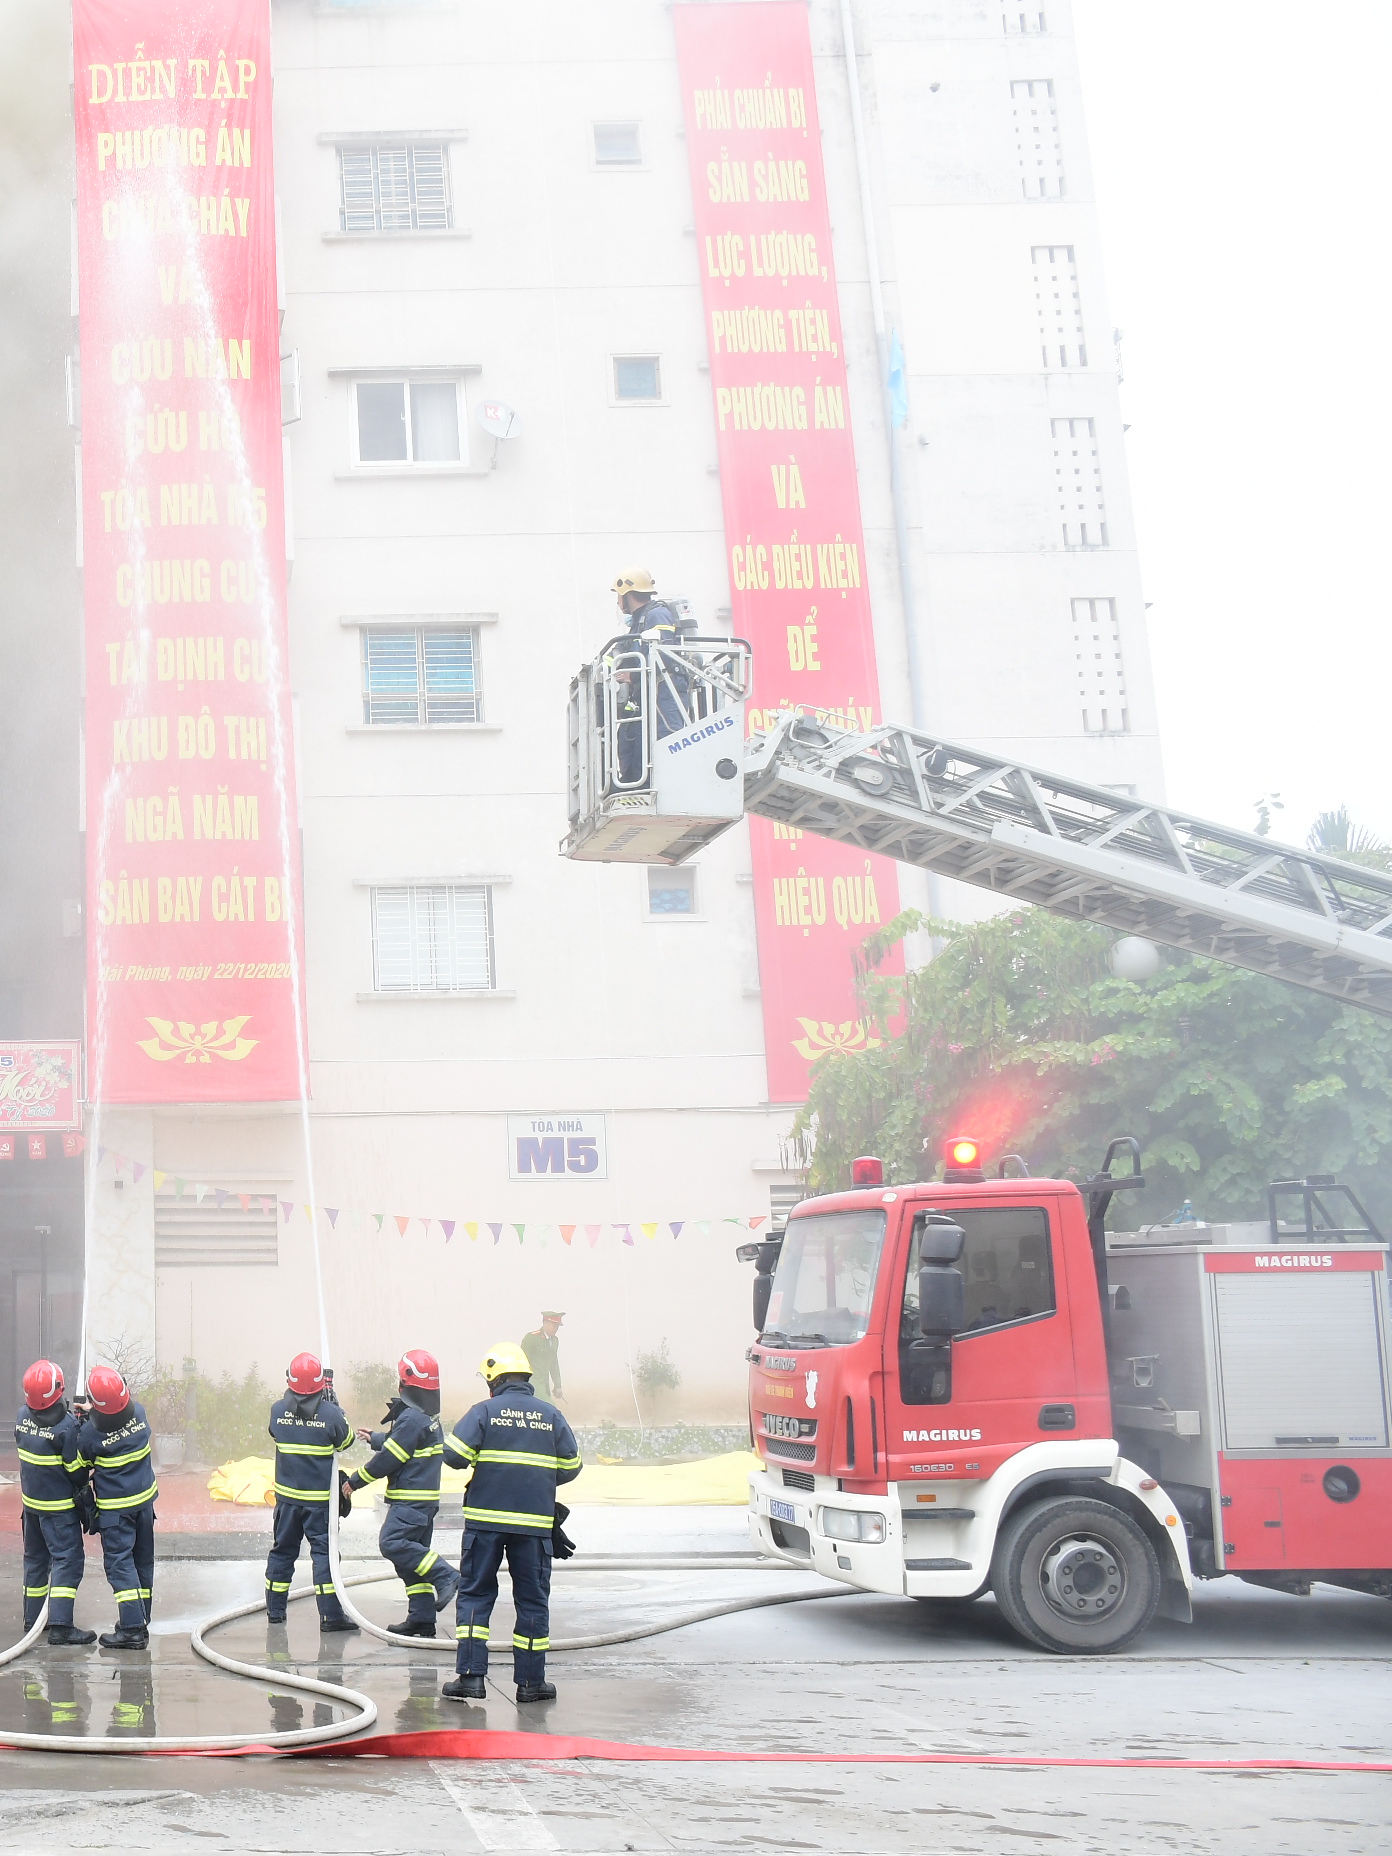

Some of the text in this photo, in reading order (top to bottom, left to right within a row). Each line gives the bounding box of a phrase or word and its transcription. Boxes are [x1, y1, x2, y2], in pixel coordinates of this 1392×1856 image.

[88, 42, 257, 108] DIỄN TẬP
[694, 71, 808, 138] PHẢI CHUẨN BỊ
[97, 119, 251, 171] PHƯƠNG ÁN
[708, 145, 809, 203] SẴN SÀNG
[180, 188, 250, 237] CHÁY
[705, 231, 828, 287] LỰC LƯỢNG,
[712, 300, 838, 362] PHƯƠNG TIỆN,
[125, 403, 188, 456] CỨU
[716, 379, 845, 431] PHƯƠNG ÁN
[101, 475, 267, 532] TÒA NHÀ M5
[770, 455, 806, 509] VÀ
[116, 559, 211, 607] CHUNG
[732, 530, 861, 599] CÁC ĐIỀU KIỆN
[106, 631, 149, 685] TÁI
[157, 636, 224, 691] ĐỊNH
[787, 606, 821, 671] ĐỂ
[113, 706, 267, 771] KHU ĐÔ THỊ
[668, 714, 736, 755] MAGIRUS
[125, 784, 259, 844] NGÃ NĂM
[100, 866, 289, 925] SÂN BAY CÁT BI
[773, 860, 880, 937] HIỆU QUẢ
[125, 964, 172, 982] Phòng,
[177, 962, 212, 981] ngày
[214, 962, 293, 979] 22/12/2020
[26, 1106, 56, 1118] 2020
[530, 1118, 583, 1132] TÒA NHÀ
[516, 1136, 599, 1174] M5
[1255, 1255, 1333, 1268] MAGIRUS
[765, 1355, 797, 1371] MAGIRUS
[101, 1434, 121, 1447] PCCC
[276, 1417, 293, 1425] PCCC
[306, 1420, 326, 1428] CNCH
[491, 1417, 553, 1432] PCCC VÀ CNCH
[525, 1410, 543, 1421] SÁT
[765, 1414, 801, 1438] IVECO
[902, 1428, 982, 1441] MAGIRUS
[909, 1463, 955, 1473] 160E30
